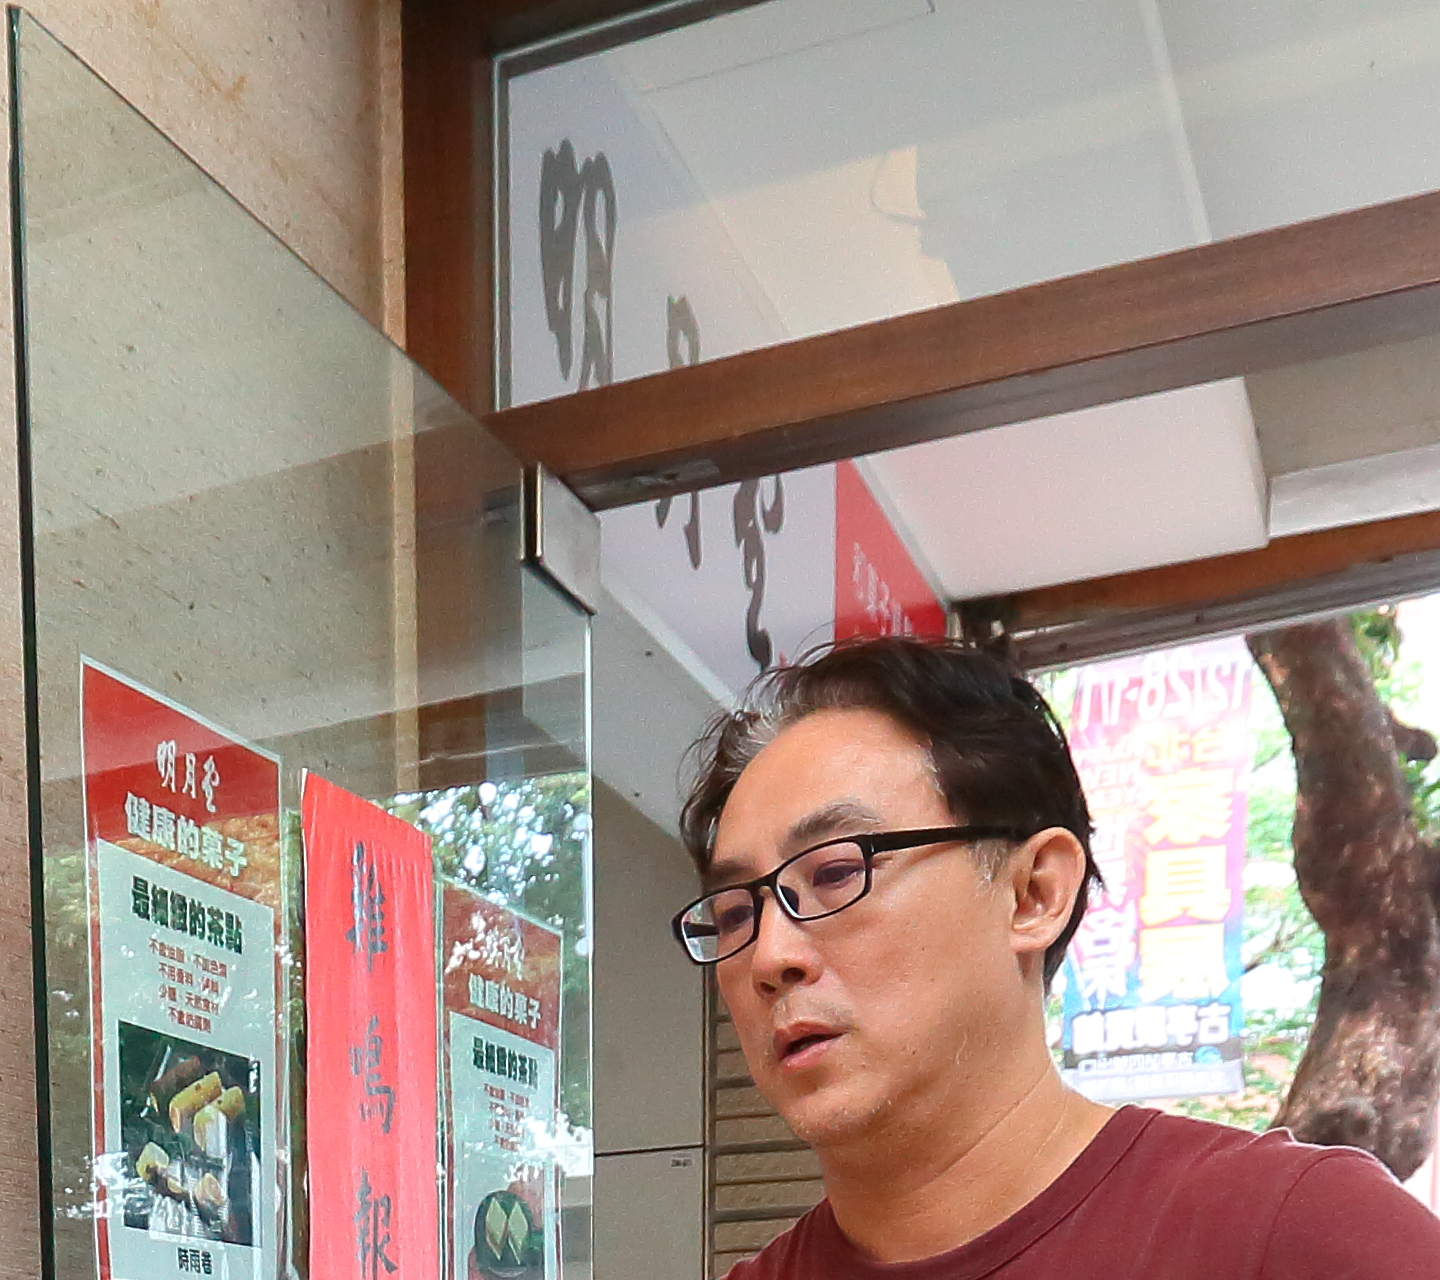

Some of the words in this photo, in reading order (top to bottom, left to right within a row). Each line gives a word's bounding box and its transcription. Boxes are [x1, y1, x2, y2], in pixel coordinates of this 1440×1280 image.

[124, 790, 248, 877] 健康的菓子
